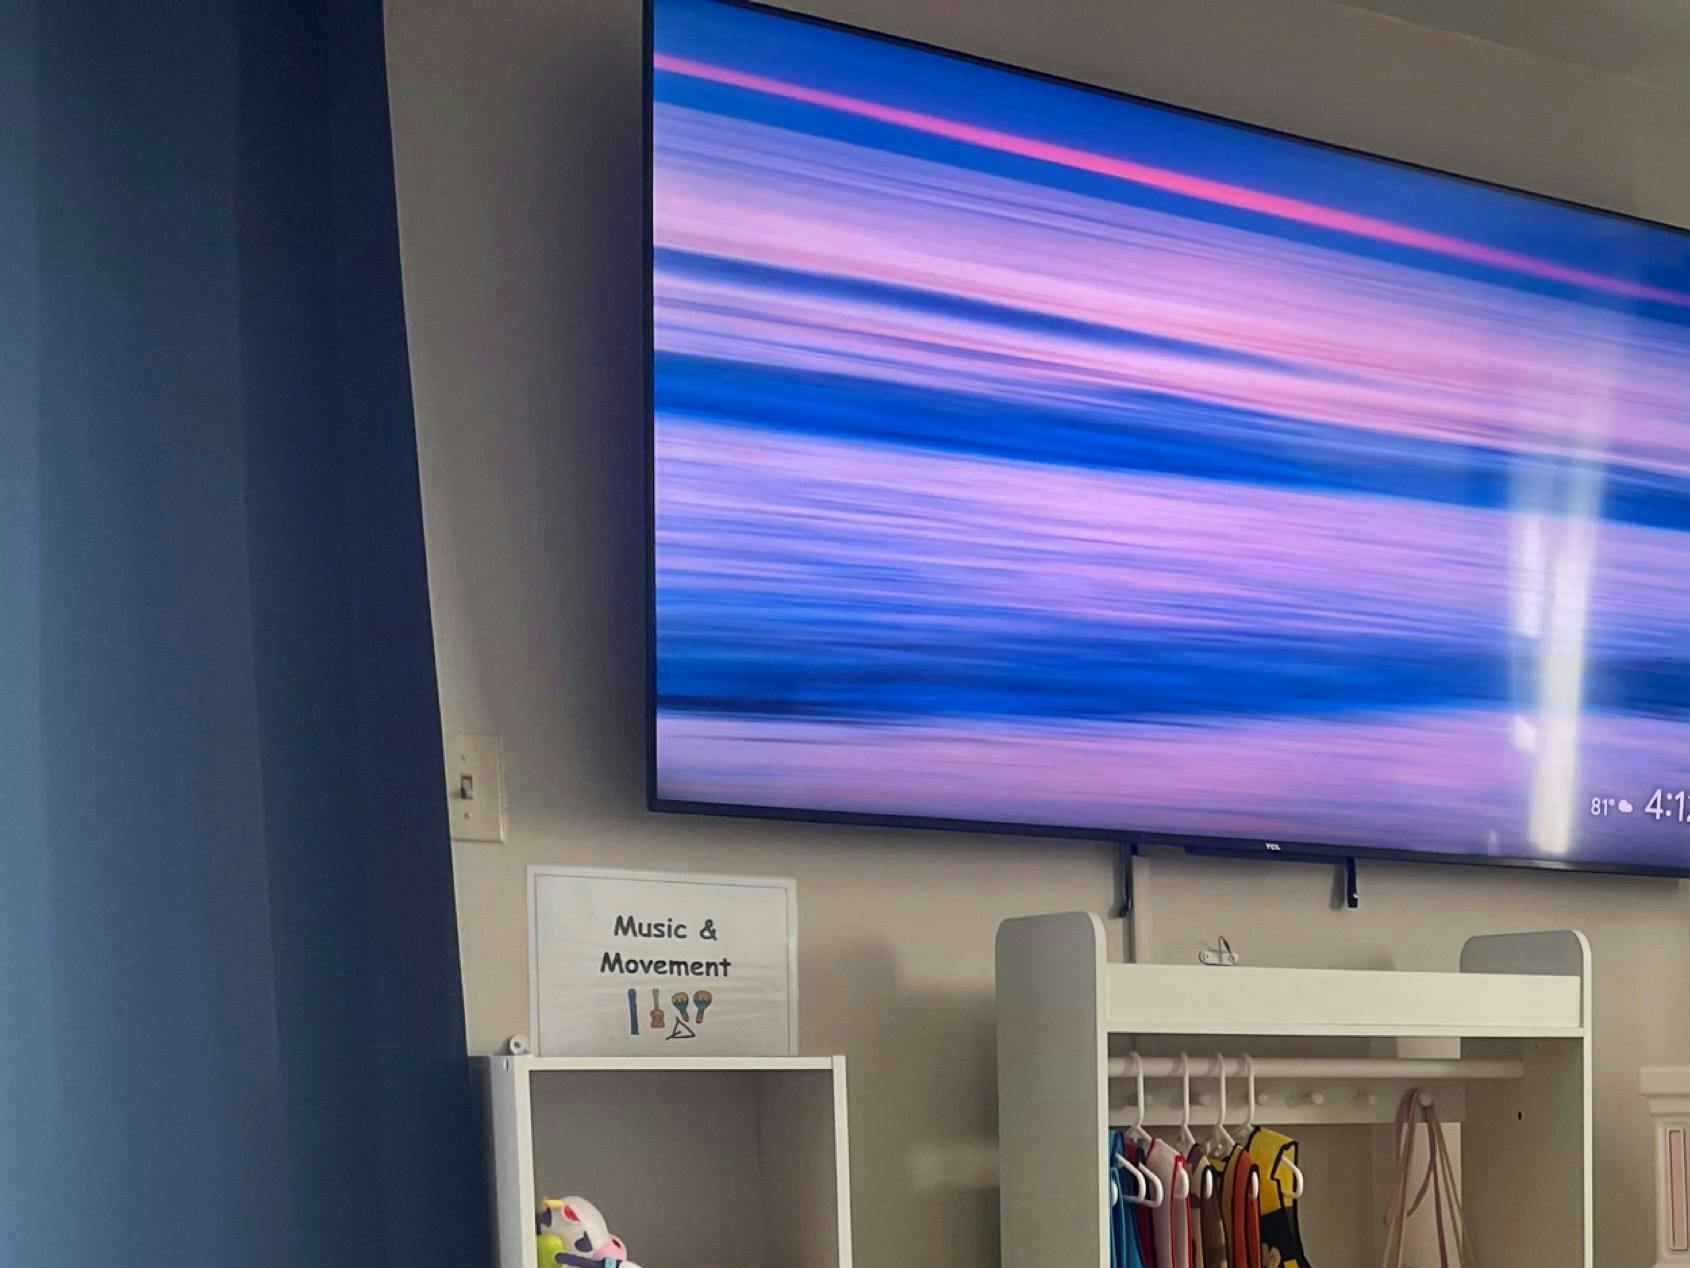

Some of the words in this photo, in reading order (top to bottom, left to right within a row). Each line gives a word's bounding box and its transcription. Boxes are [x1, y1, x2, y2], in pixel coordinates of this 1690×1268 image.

[612, 915, 688, 940] Music
[699, 918, 718, 942] &
[599, 951, 732, 978] Movement
